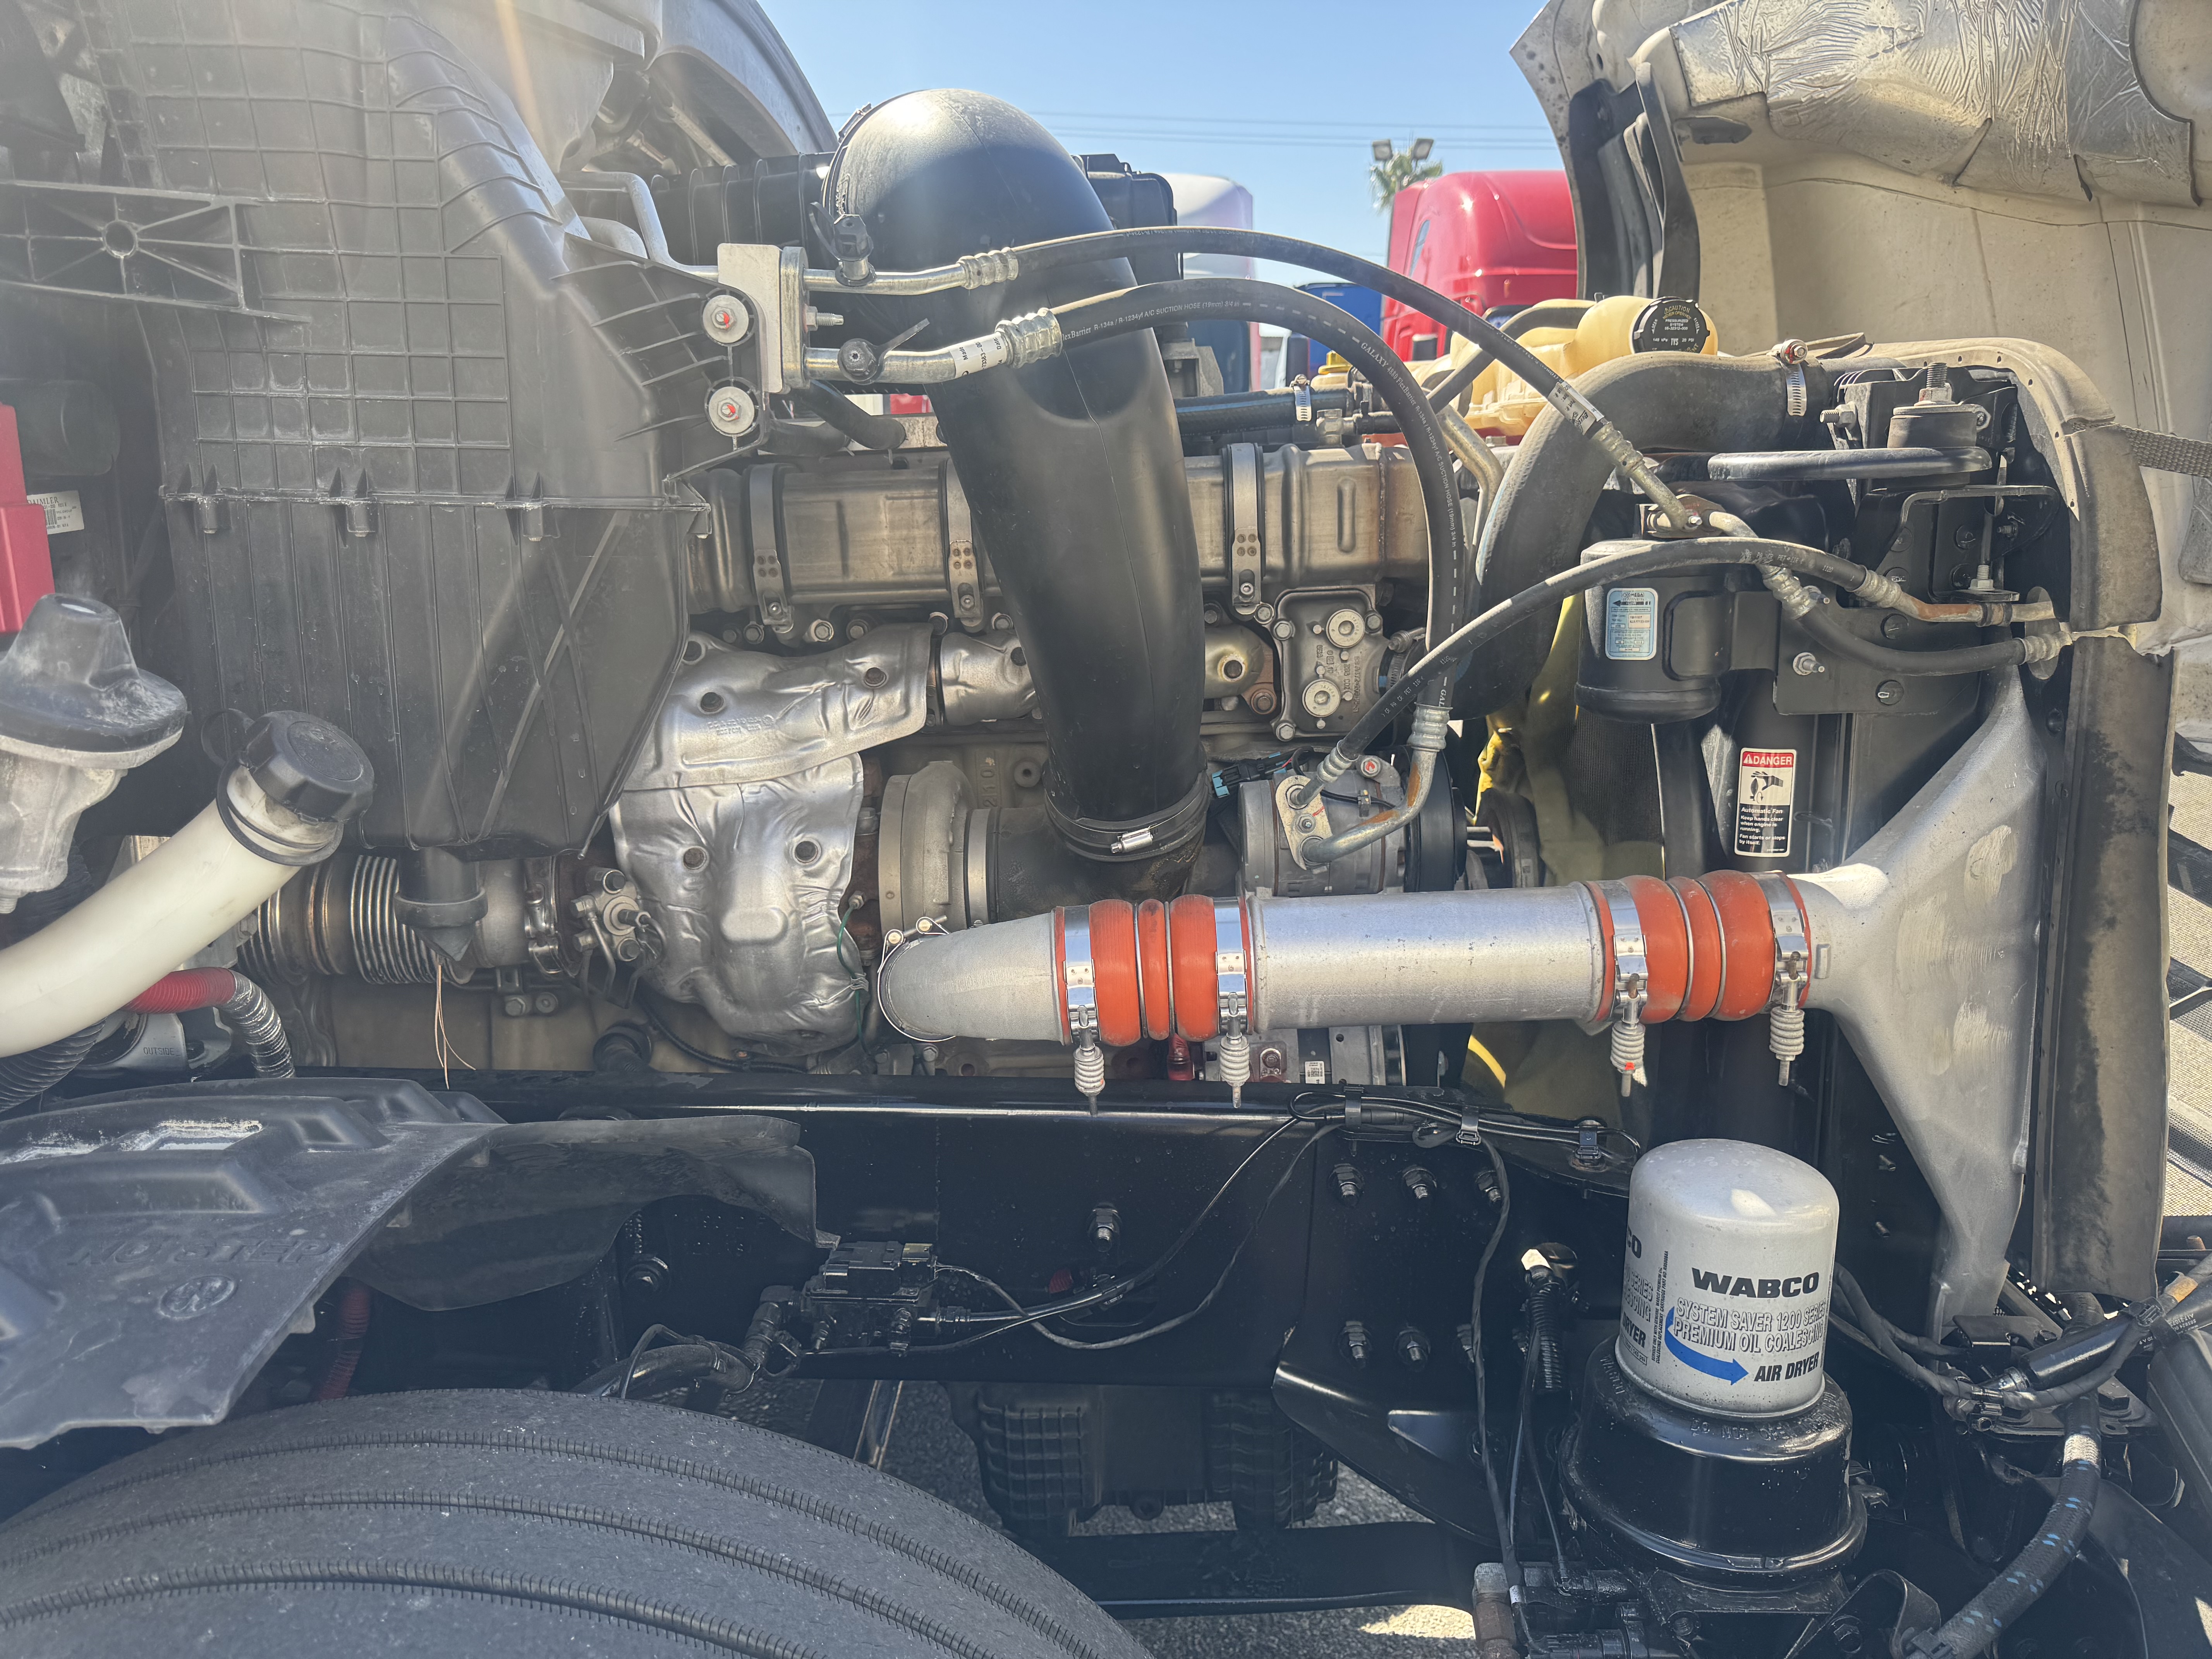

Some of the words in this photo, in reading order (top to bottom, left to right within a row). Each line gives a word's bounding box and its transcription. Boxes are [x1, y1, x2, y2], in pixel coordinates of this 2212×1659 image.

[1063, 327, 1091, 341] lexBarrier
[1094, 321, 1114, 331] R-134a
[1156, 304, 1182, 315] SUCTION
[1669, 305, 1690, 313] CAUTION
[1361, 343, 1389, 368] GALAXY
[1387, 366, 1397, 380] 4880
[1396, 377, 1416, 405] FlexBarrier
[1438, 462, 1449, 489] SUCTION
[1404, 687, 1412, 695] PET
[1753, 756, 1792, 766] DANGER
[143, 1047, 175, 1055] OUTSIDE
[174, 1240, 331, 1263] STEP
[1692, 1267, 1820, 1298] WABCO
[1622, 1311, 1646, 1348] DRYER
[1677, 1297, 1728, 1329] SYSTEM
[1731, 1310, 1772, 1332] SAVER
[1776, 1309, 1801, 1331] 1200
[1803, 1299, 1828, 1328] SERIES
[1673, 1319, 1735, 1351] PREMIUM
[1739, 1333, 1762, 1353] OIL
[1764, 1319, 1824, 1353] COALESCING
[1754, 1364, 1782, 1382] AIR
[1785, 1352, 1820, 1381] DRYER
